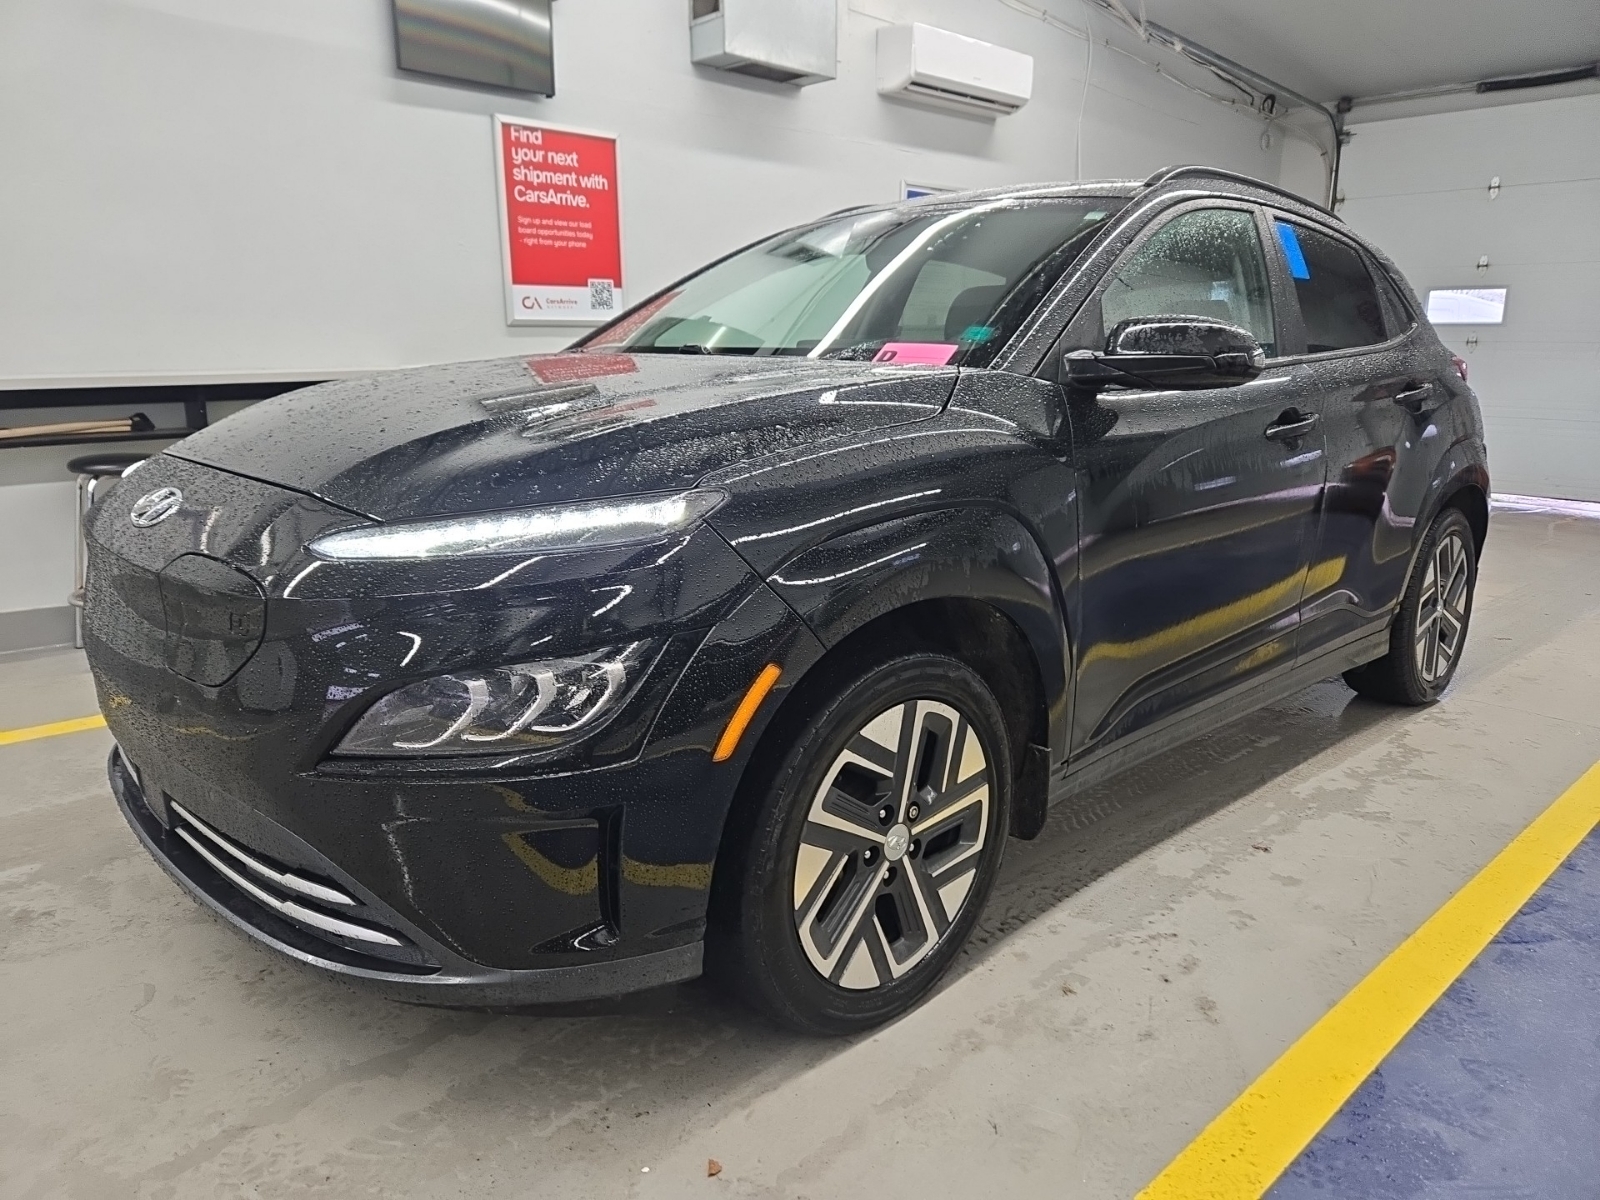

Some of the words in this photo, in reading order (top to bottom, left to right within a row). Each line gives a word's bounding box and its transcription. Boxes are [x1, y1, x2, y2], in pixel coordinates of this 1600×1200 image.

[510, 125, 542, 145] Find
[511, 146, 545, 165] your
[547, 151, 579, 168] next
[512, 165, 577, 187] shipment
[579, 173, 609, 191] with
[514, 185, 590, 208] CarsArrive.
[517, 215, 531, 225] Sign
[532, 218, 541, 226] up
[541, 218, 553, 226] and
[576, 231, 594, 241] today
[523, 237, 538, 247] right
[538, 237, 553, 246] from
[553, 240, 568, 249] your
[545, 297, 578, 305] CarsArrive
[876, 350, 898, 362] D
